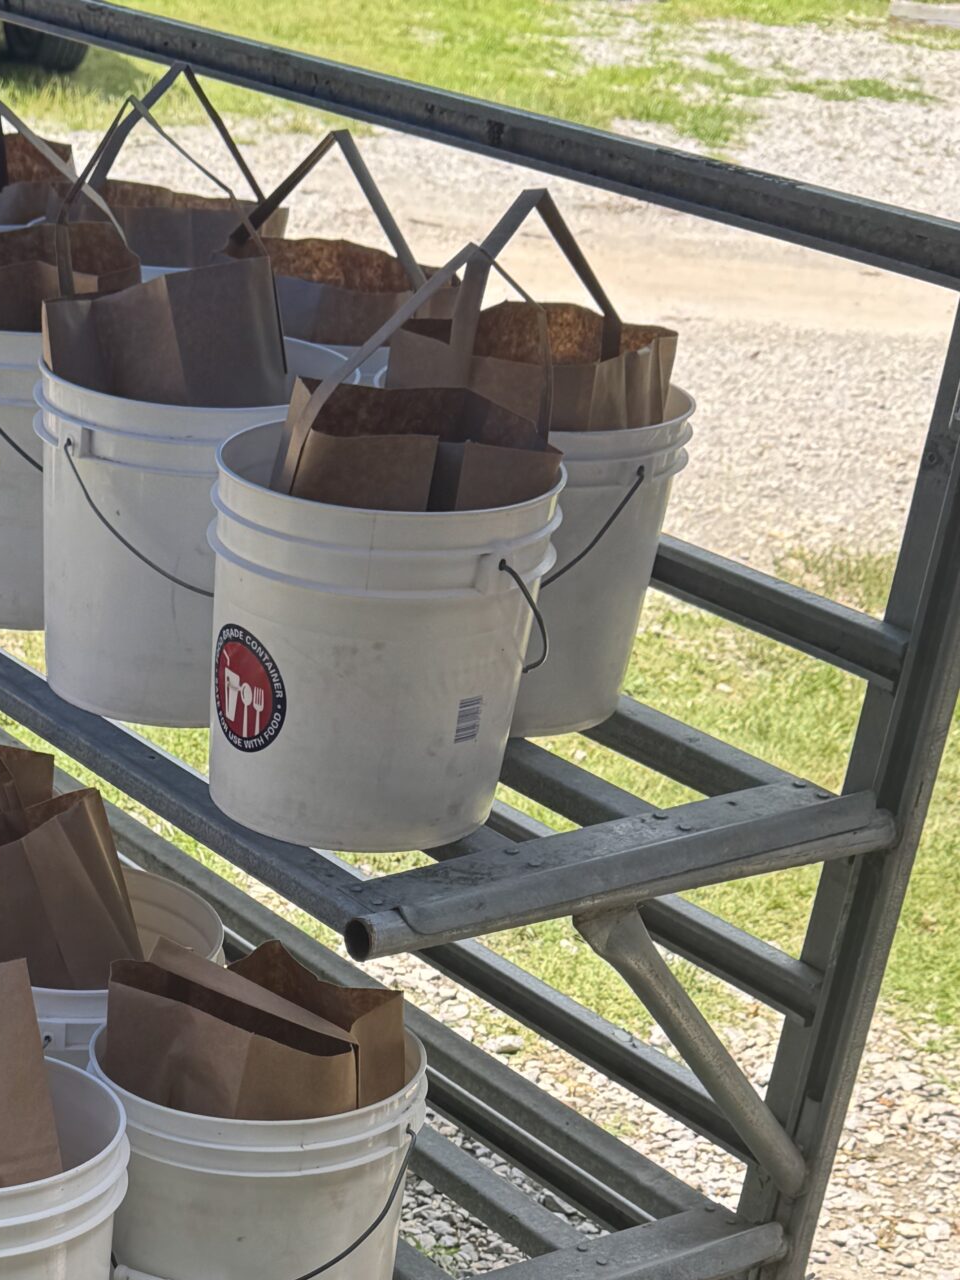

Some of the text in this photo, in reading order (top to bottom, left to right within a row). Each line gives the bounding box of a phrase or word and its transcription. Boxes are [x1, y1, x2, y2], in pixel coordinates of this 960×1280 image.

[245, 635, 284, 699] CONTAINER
[218, 709, 229, 733] FOR
[228, 731, 243, 748] USE
[243, 736, 265, 750] WITH
[264, 713, 283, 739] FOOD
